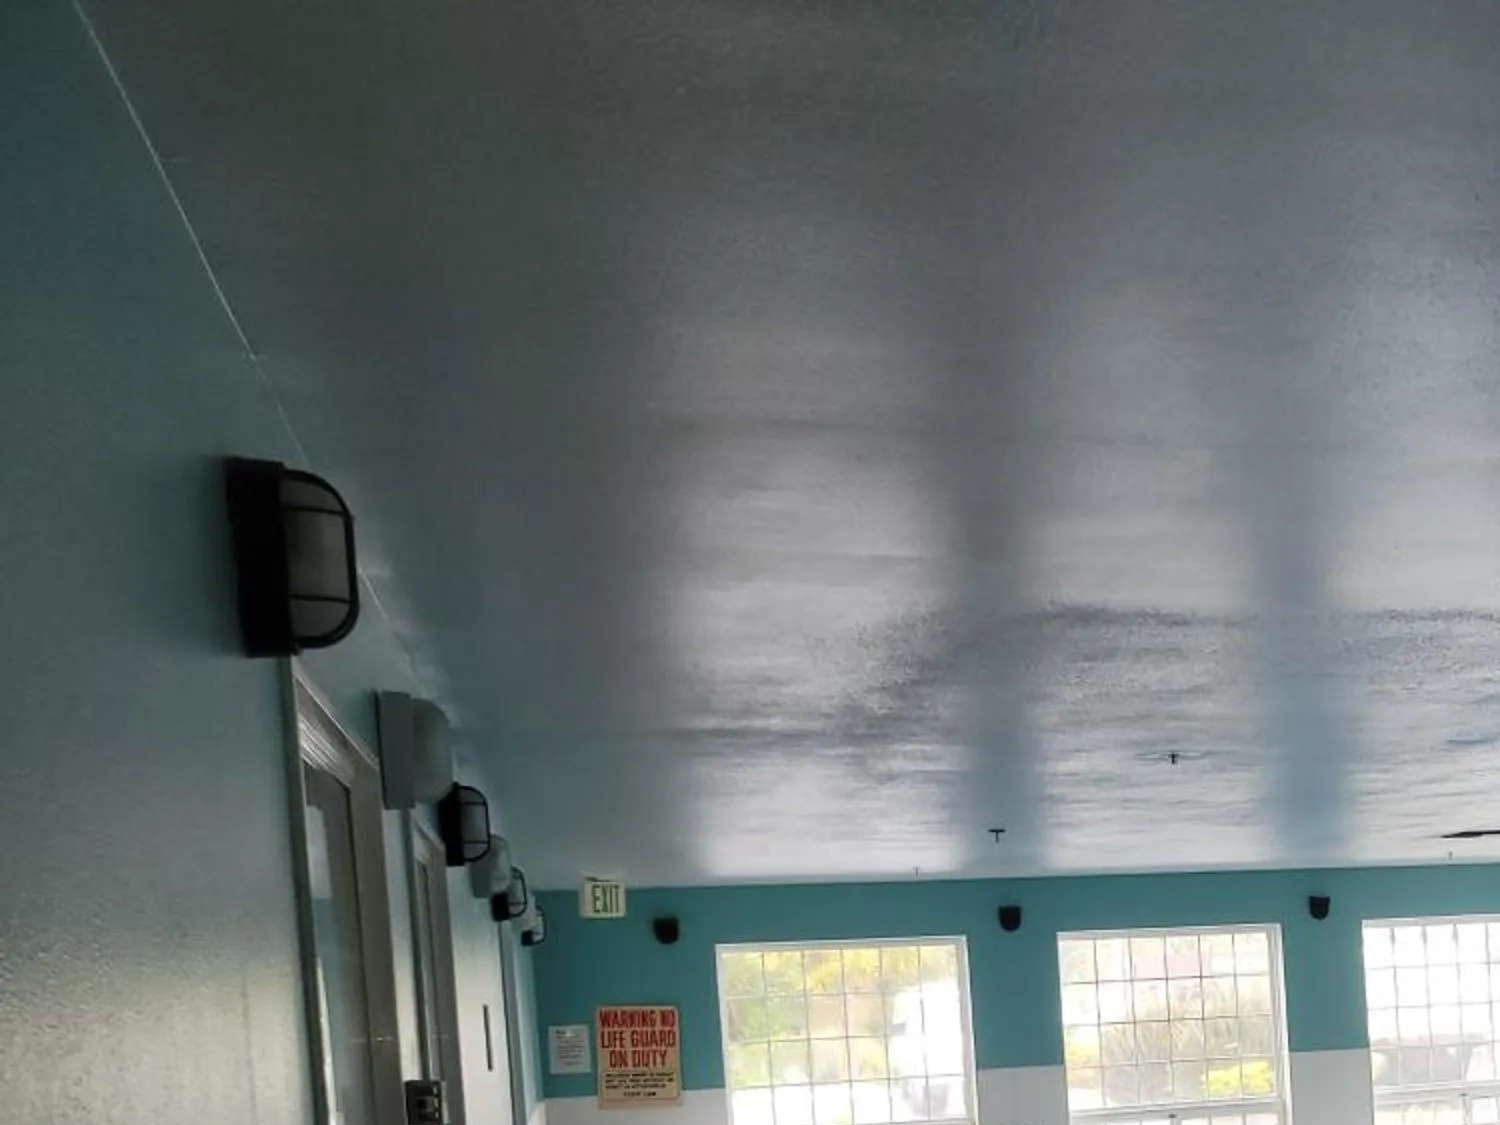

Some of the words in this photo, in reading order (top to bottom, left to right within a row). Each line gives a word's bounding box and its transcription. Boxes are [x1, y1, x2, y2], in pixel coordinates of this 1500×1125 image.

[591, 884, 619, 913] EXIT
[599, 1009, 656, 1028] WARNING
[601, 1030, 625, 1049] LIFE
[631, 1029, 676, 1048] GUARD
[609, 1049, 628, 1068] ON
[632, 1048, 667, 1068] DUTY
